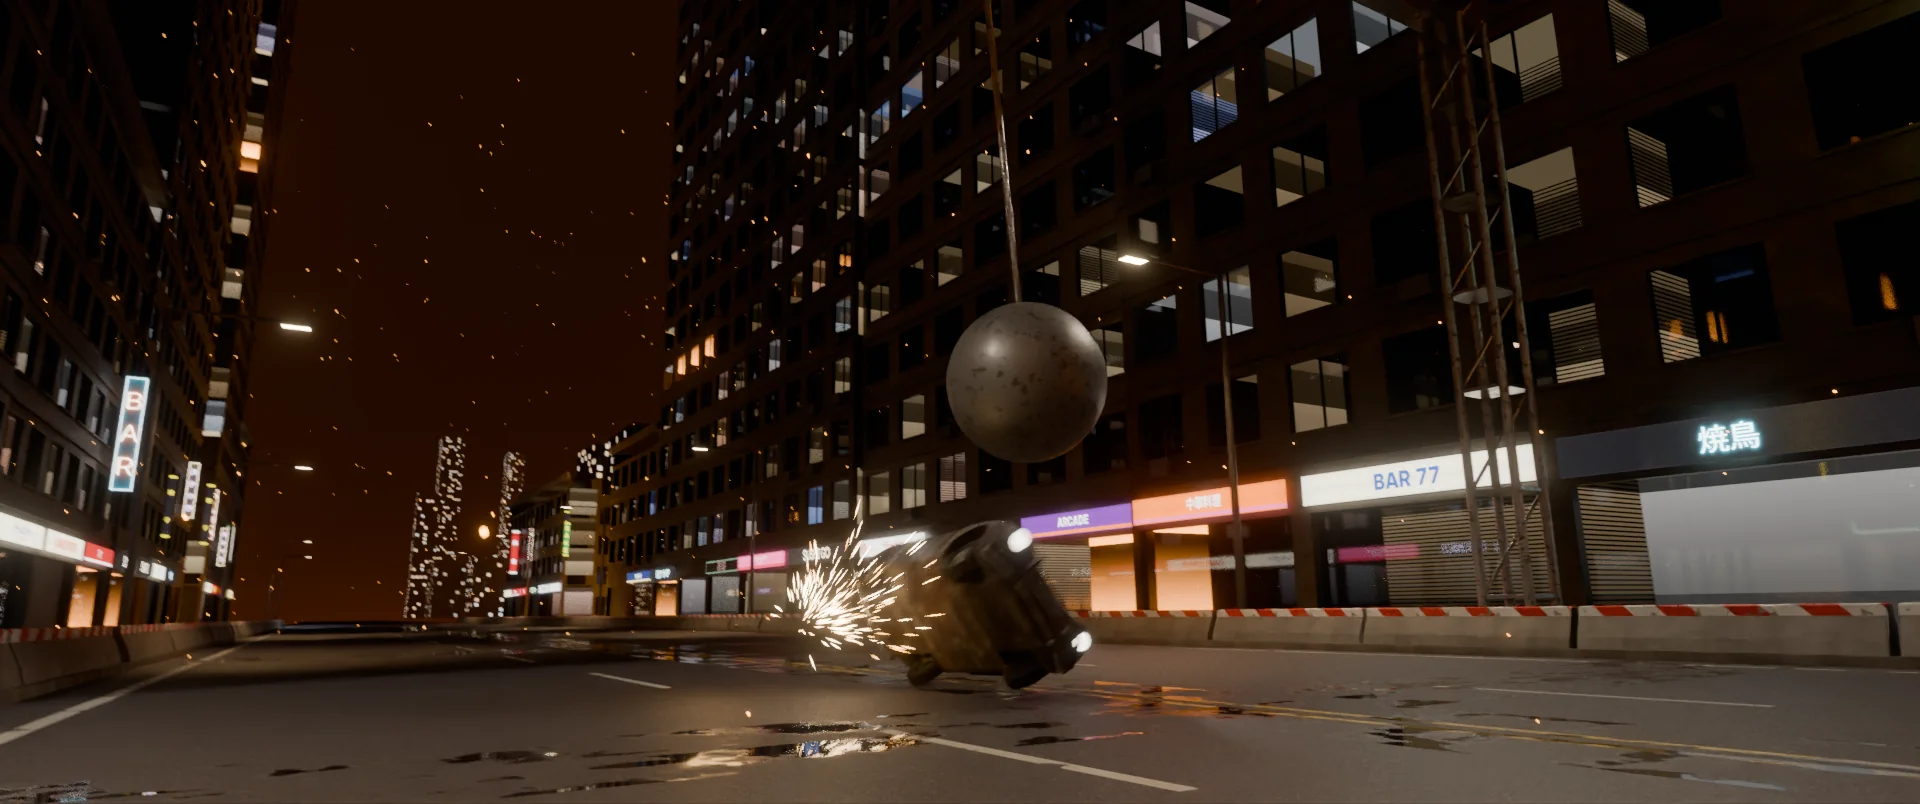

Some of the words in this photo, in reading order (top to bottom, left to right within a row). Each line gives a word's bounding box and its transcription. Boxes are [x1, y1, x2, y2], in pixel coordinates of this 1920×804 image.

[115, 391, 144, 477] BAR
[1697, 420, 1761, 455] 焼鳥
[1373, 470, 1410, 490] BAR
[1416, 465, 1439, 485] 77
[1057, 514, 1090, 528] ARCADE
